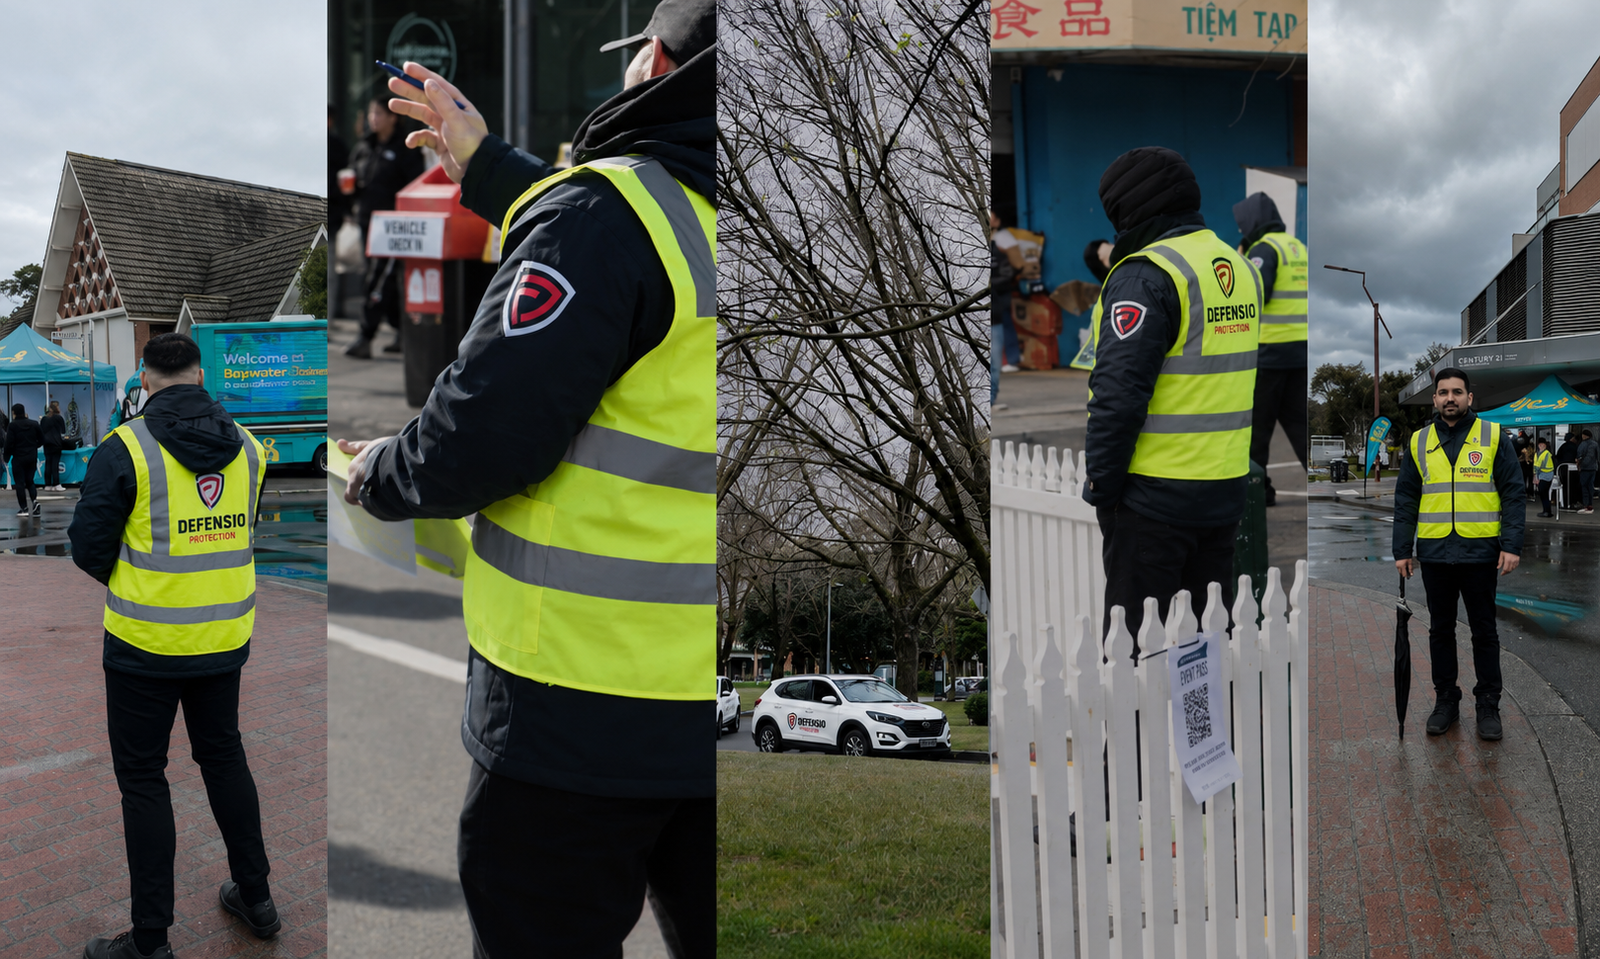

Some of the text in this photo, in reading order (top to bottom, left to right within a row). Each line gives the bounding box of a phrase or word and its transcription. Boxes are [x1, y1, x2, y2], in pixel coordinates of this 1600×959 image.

[991, 0, 1110, 40] 食品
[1182, 1, 1298, 45] TIỆM TẠP
[384, 220, 427, 235] VEHICLE
[388, 237, 423, 252] CHECK IN
[1207, 303, 1256, 323] DEFENSIO
[1214, 323, 1250, 335] PROTECTION
[223, 352, 289, 365] Welcome
[1458, 355, 1494, 364] CENTURY
[178, 513, 246, 534] DEFENSIO
[189, 532, 236, 544] PROTECTION
[1180, 660, 1208, 687] EVENT PASS
